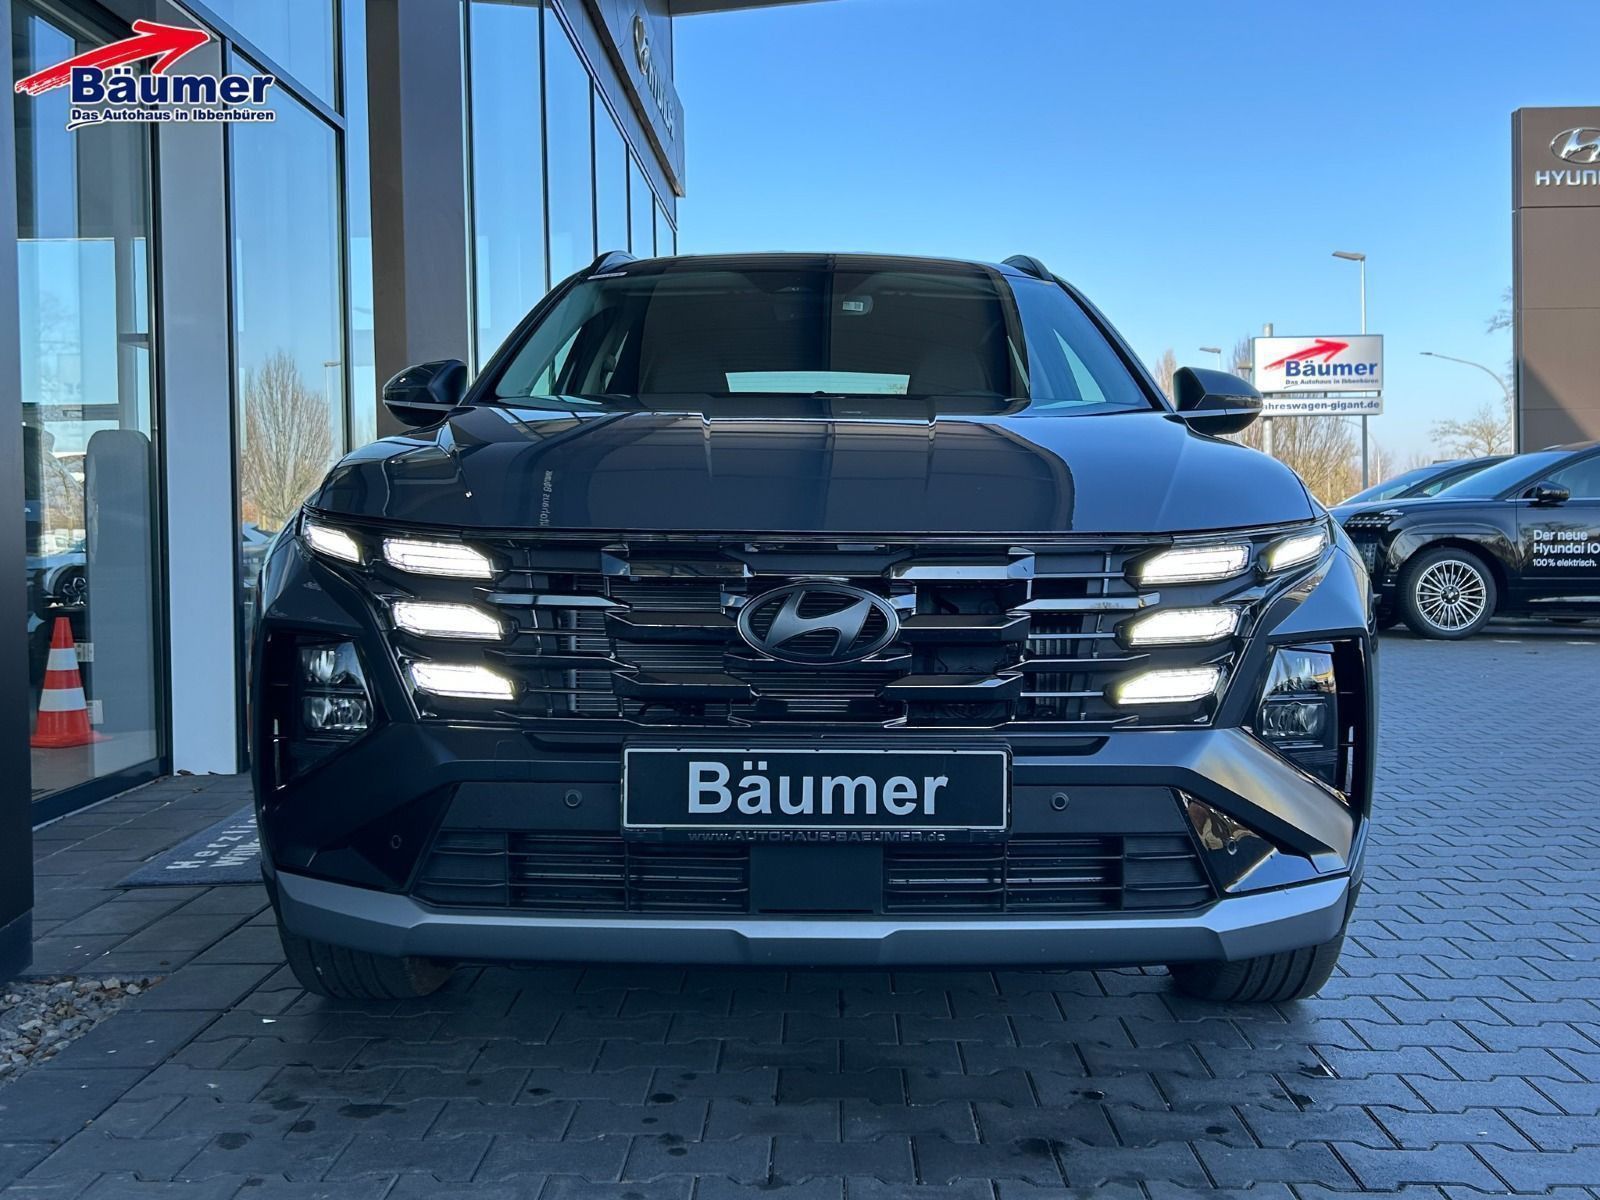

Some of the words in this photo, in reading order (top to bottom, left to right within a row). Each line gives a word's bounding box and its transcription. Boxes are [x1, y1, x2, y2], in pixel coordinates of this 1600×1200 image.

[1535, 169, 1600, 186] HYUN
[1285, 360, 1379, 377] Bäumer
[1533, 529, 1555, 541] Der
[1557, 530, 1588, 541] neue
[1533, 542, 1585, 556] Hyundai
[1533, 558, 1555, 567] 100%
[1556, 558, 1597, 567] elektrisch.
[688, 760, 949, 815] Bäumer
